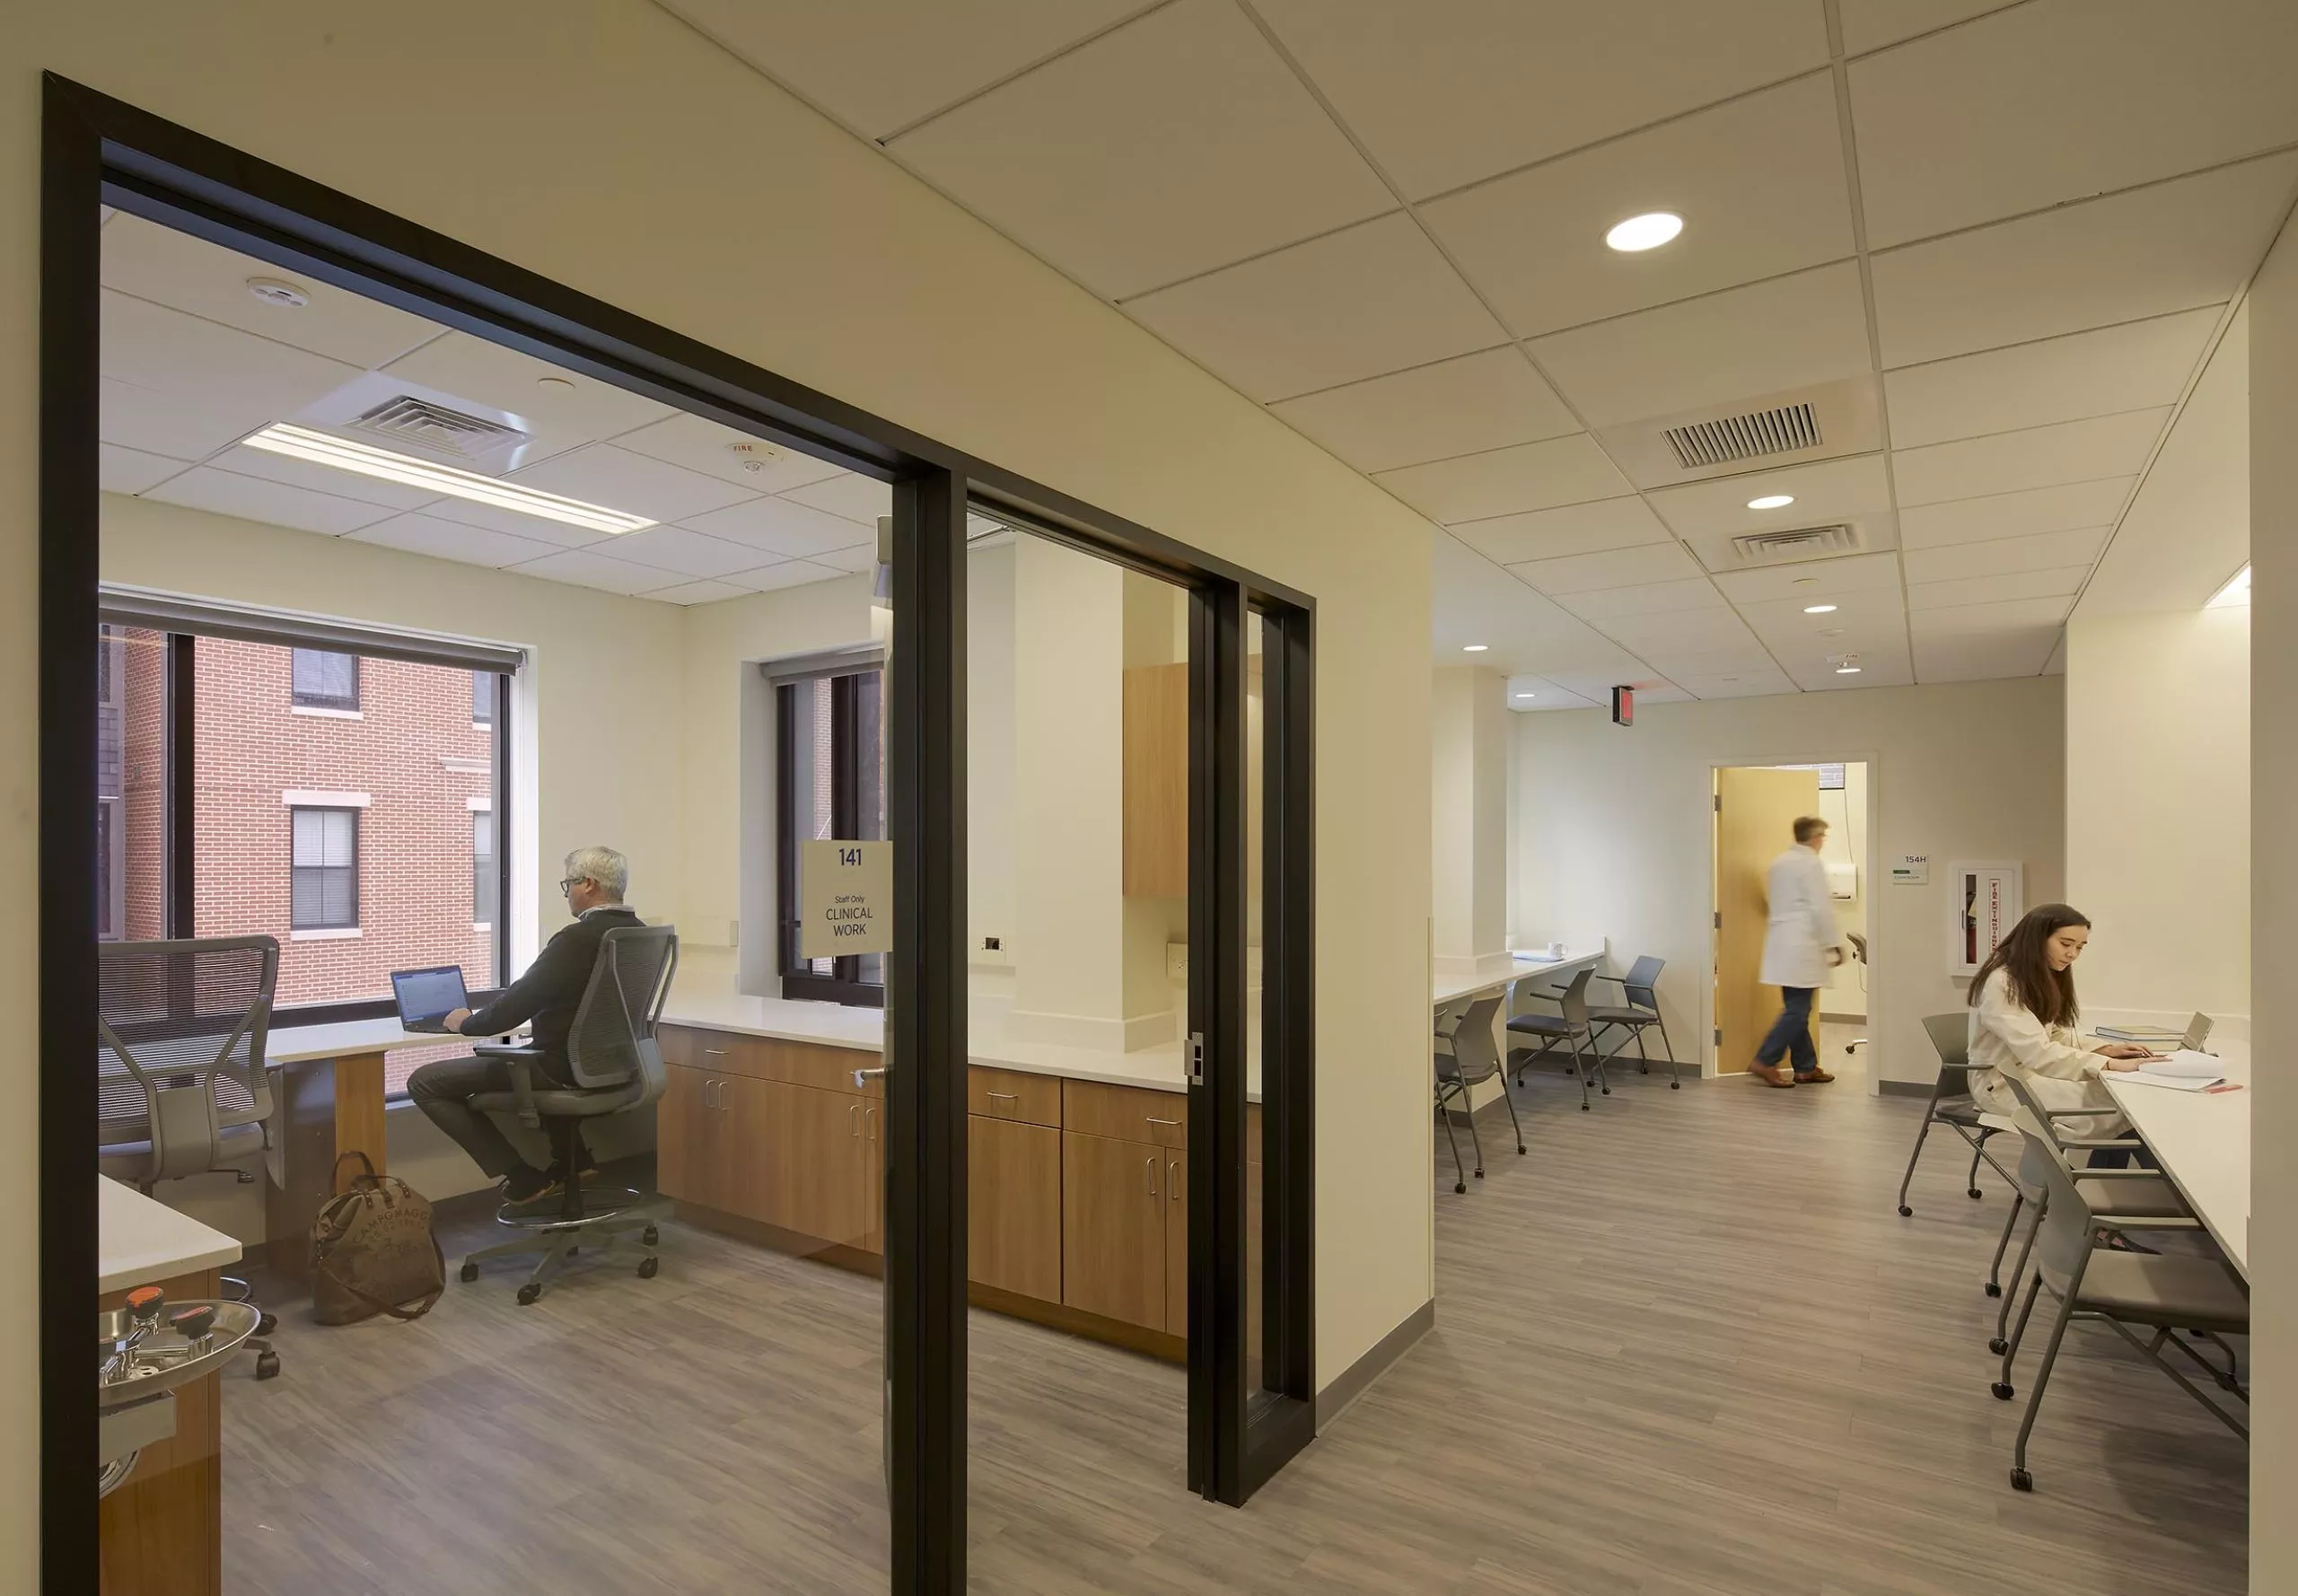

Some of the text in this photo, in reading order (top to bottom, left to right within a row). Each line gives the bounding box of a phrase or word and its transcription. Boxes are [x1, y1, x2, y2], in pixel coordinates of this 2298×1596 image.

[838, 848, 862, 866] 141
[1906, 855, 1926, 864] 154H
[835, 895, 865, 904] Staff Only
[826, 908, 873, 921] CLINICAL
[833, 924, 866, 936] WORK
